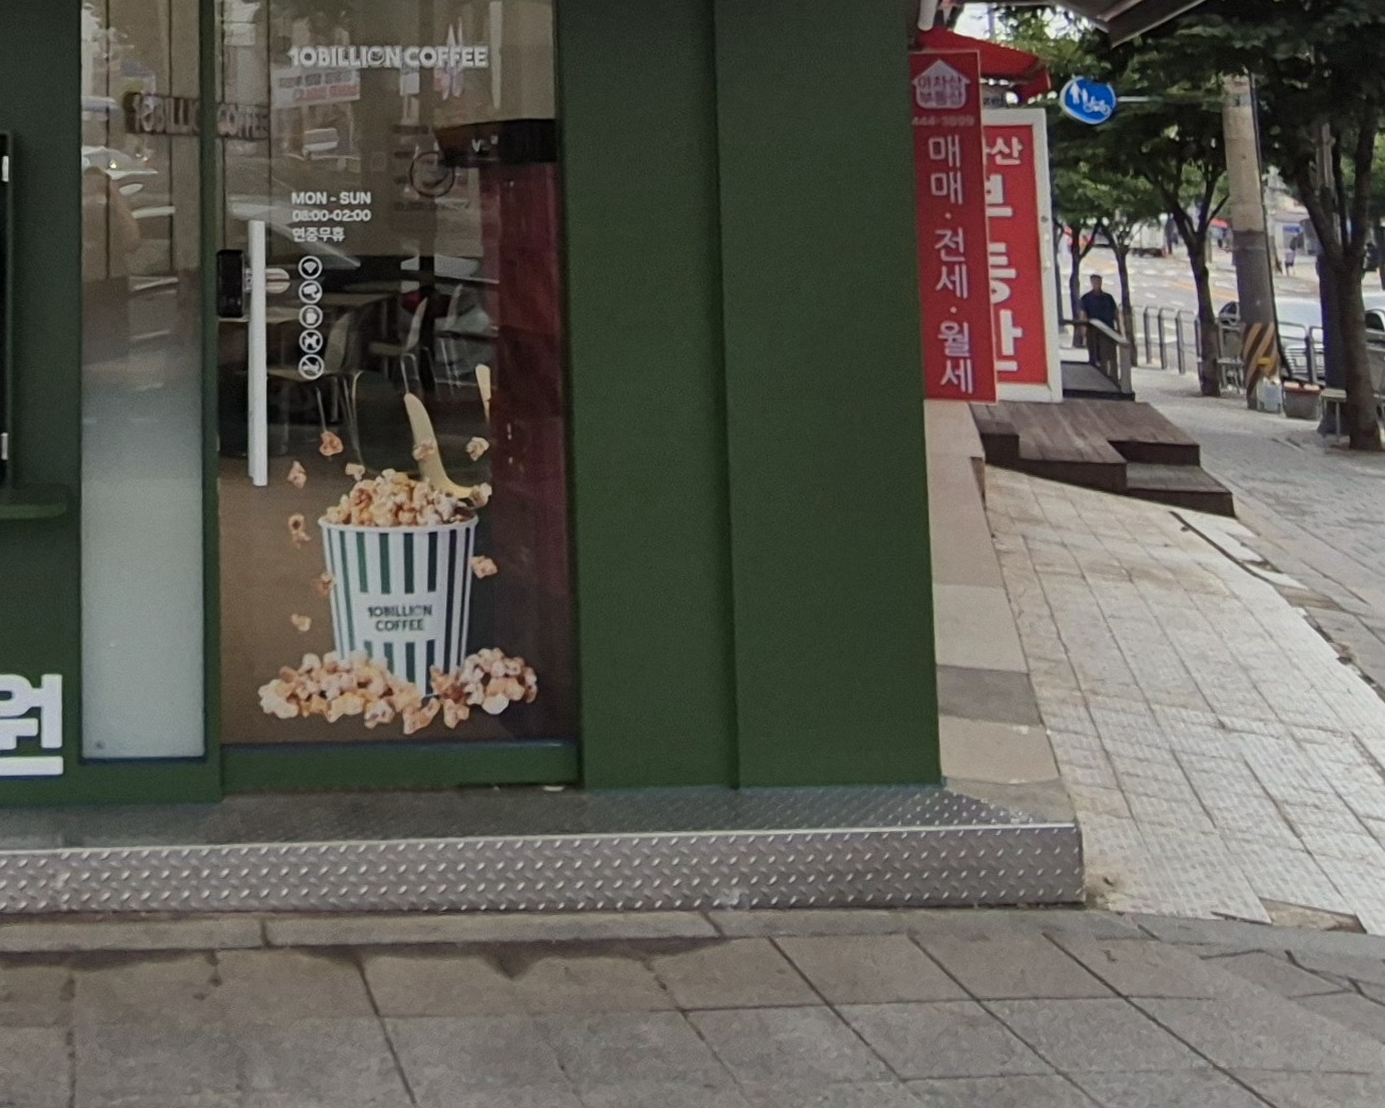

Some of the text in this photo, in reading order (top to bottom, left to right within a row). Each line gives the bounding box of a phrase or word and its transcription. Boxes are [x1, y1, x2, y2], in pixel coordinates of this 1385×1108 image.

[403, 45, 489, 69] COFFEE
[291, 191, 328, 205] MON
[339, 191, 372, 205] SUN
[292, 226, 346, 242] 연중무휴
[375, 618, 425, 632] COFFEE
